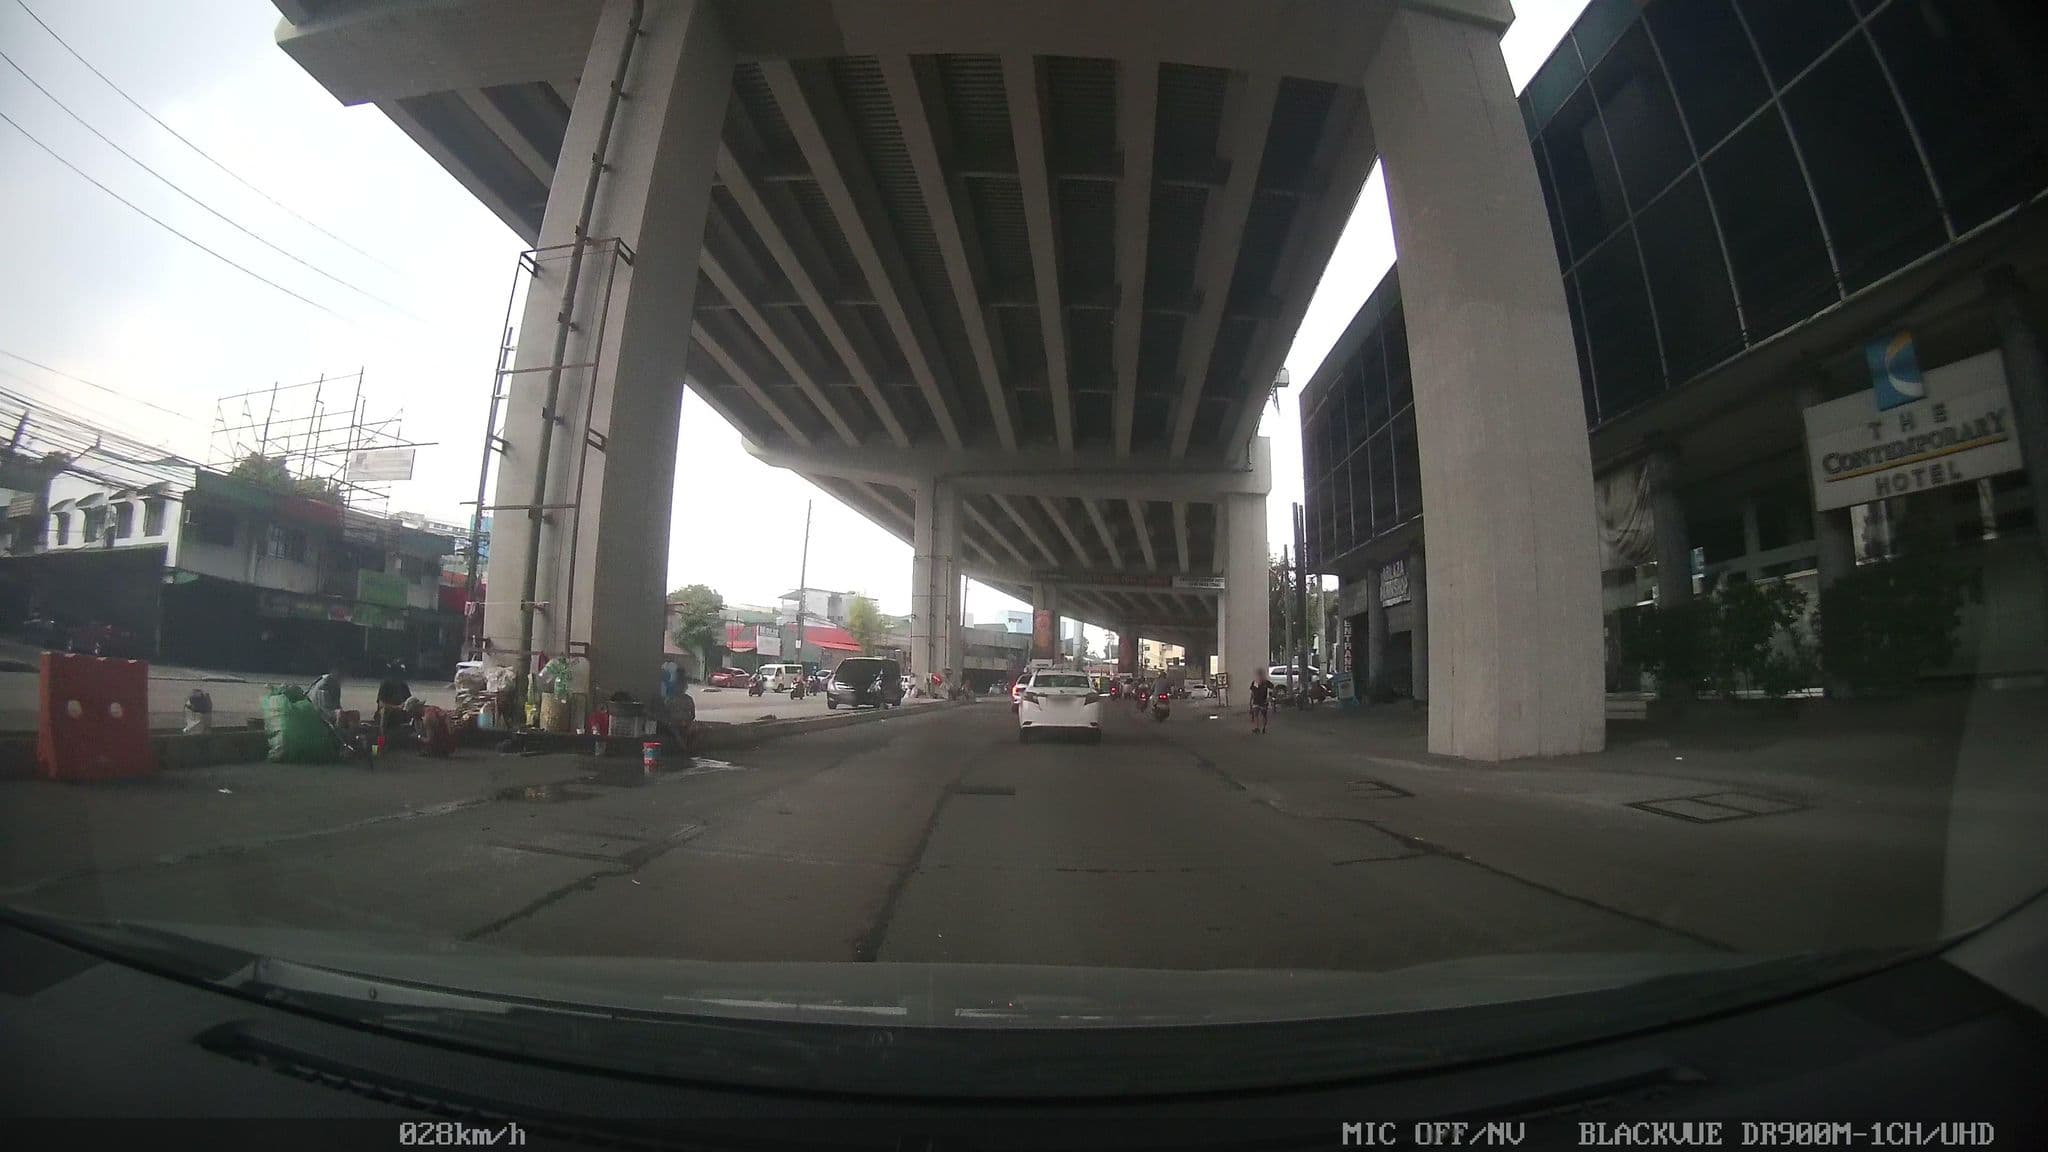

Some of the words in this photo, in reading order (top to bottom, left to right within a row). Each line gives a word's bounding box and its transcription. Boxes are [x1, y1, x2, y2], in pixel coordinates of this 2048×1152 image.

[1822, 407, 2006, 474] CONTEMPORARY
[1867, 402, 1948, 441] THE
[1875, 462, 1963, 496] HOTEL
